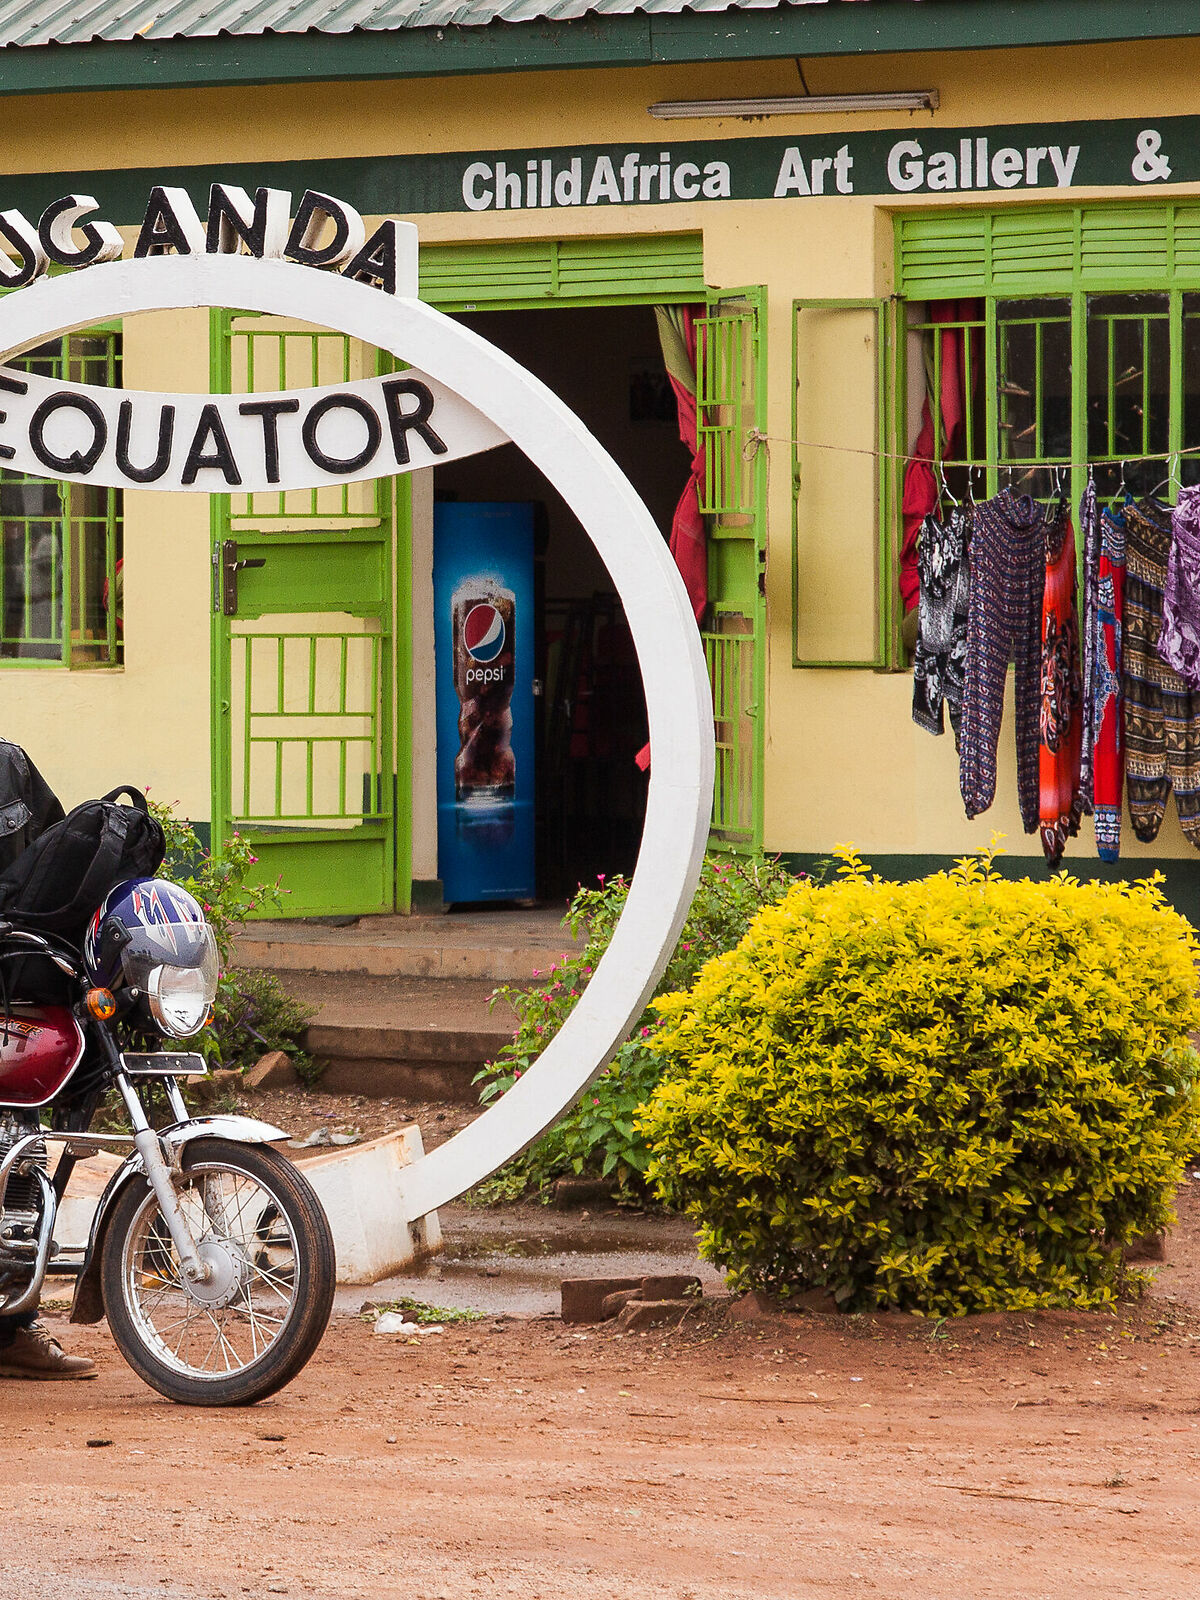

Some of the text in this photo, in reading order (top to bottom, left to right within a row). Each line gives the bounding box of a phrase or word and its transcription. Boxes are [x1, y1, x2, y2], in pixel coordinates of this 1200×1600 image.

[462, 129, 1173, 211] ChildAfrica Art Gallery &
[466, 665, 504, 685] pepsi
